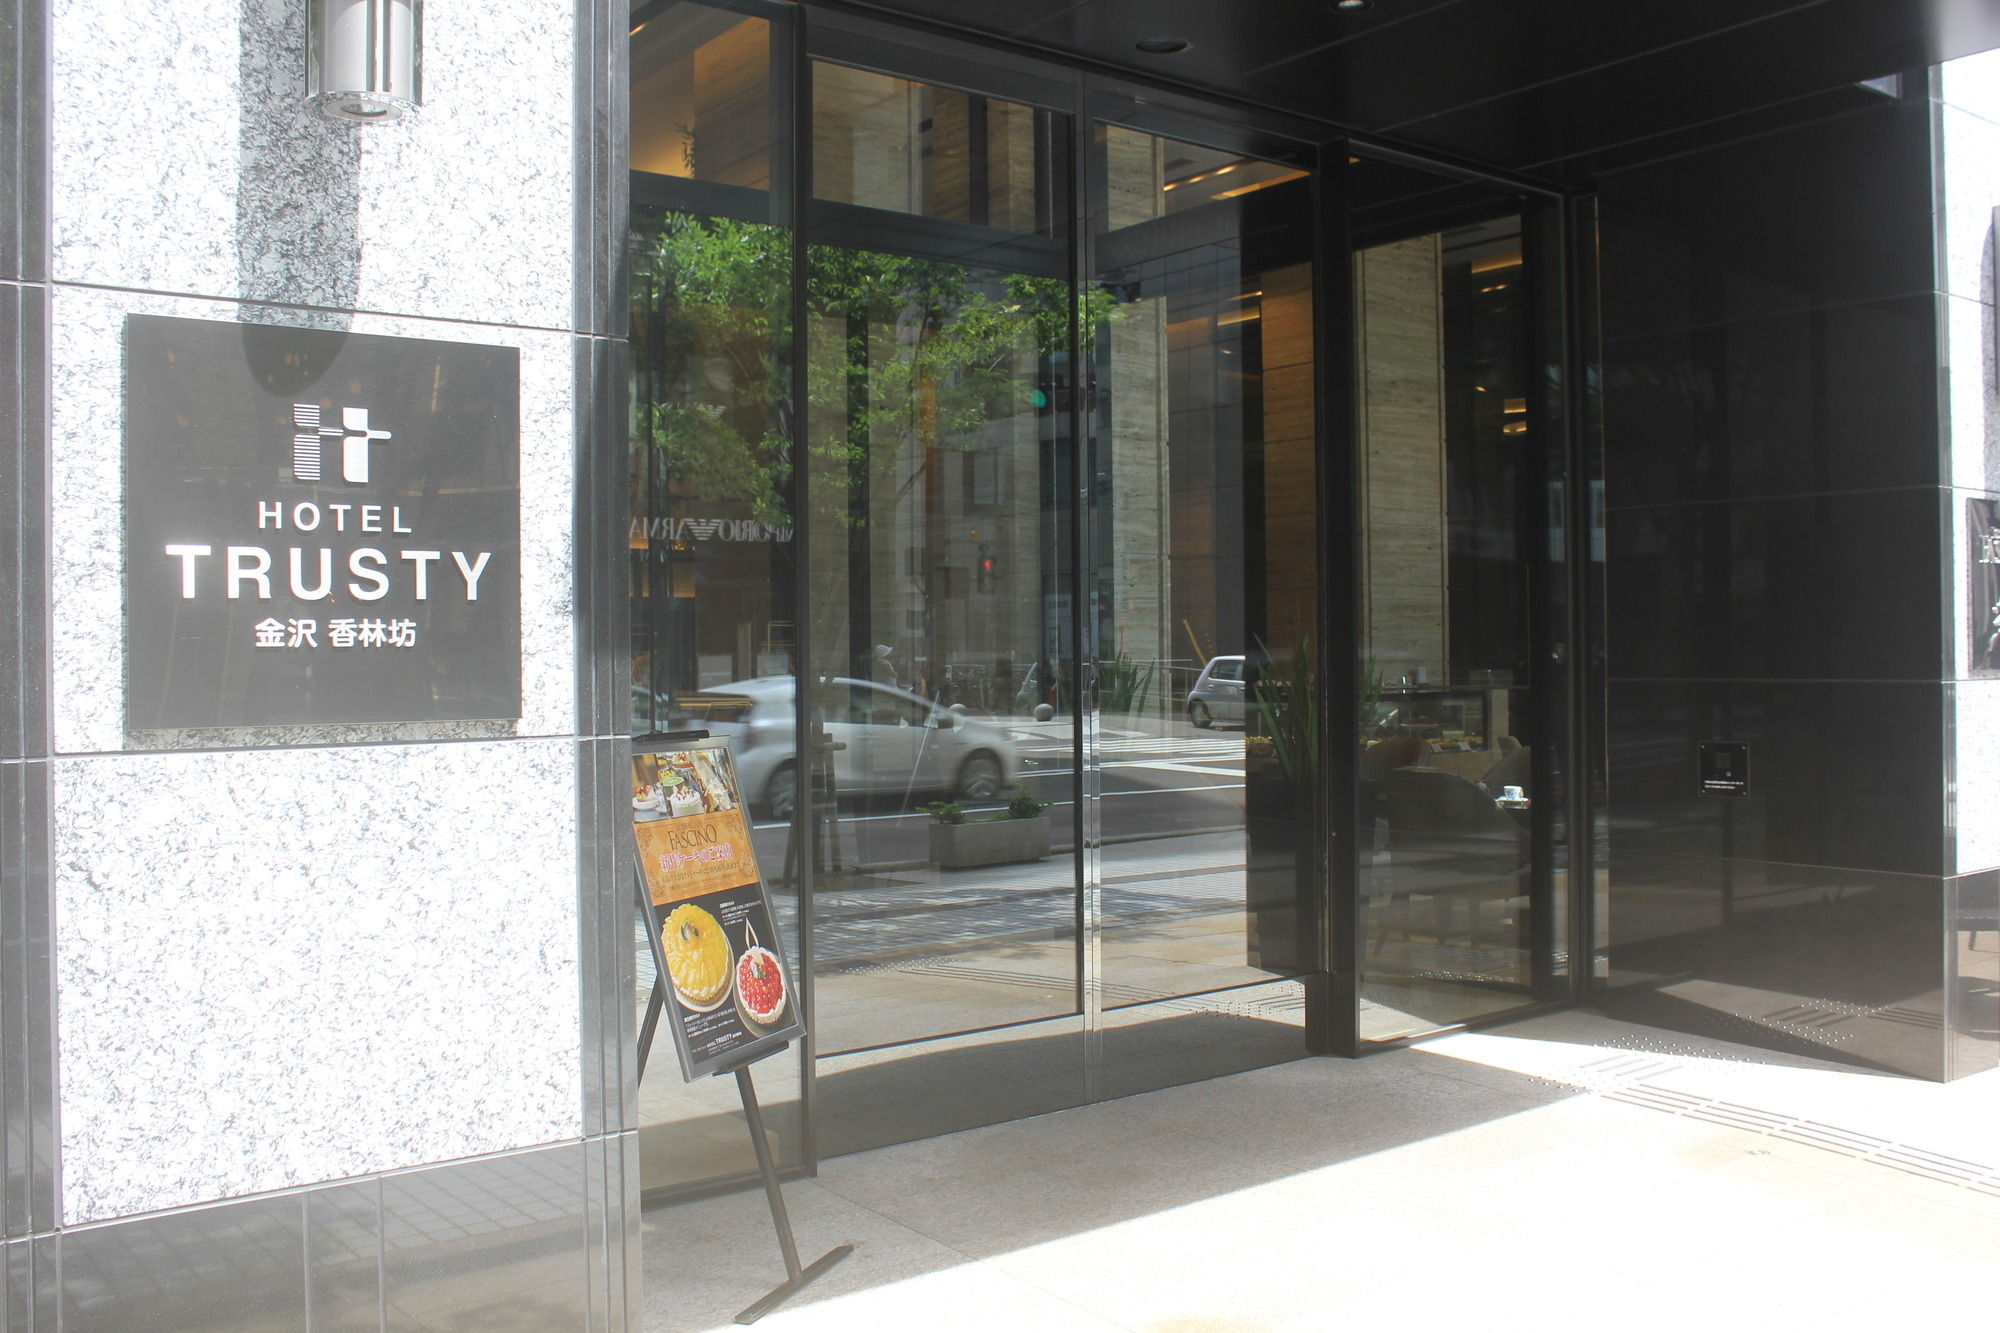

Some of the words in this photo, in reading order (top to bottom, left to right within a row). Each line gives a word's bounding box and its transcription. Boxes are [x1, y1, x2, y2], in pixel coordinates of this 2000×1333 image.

[258, 501, 412, 533] HOTEL
[165, 544, 491, 601] TRUSTY
[254, 618, 318, 648] 金沢
[328, 617, 417, 648] 香林坊
[668, 824, 718, 850] FASCINO
